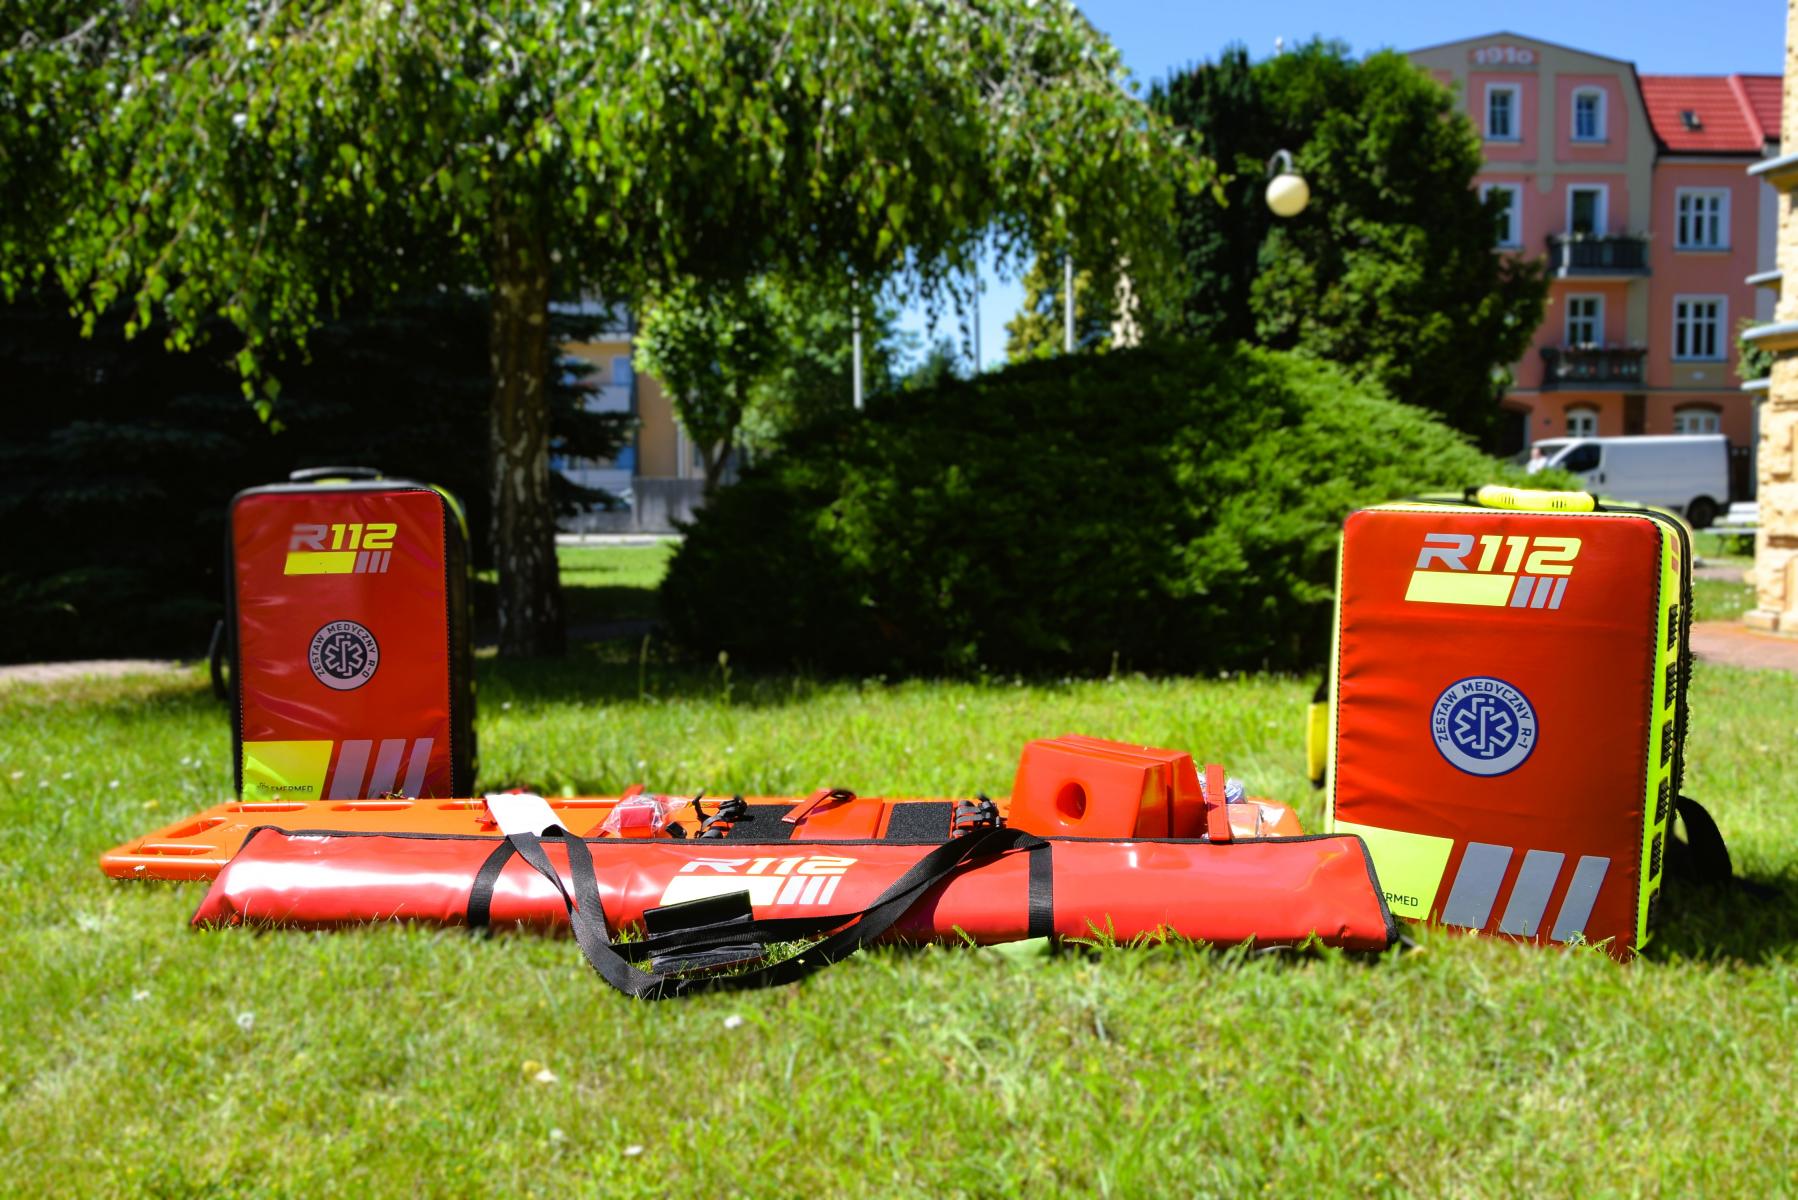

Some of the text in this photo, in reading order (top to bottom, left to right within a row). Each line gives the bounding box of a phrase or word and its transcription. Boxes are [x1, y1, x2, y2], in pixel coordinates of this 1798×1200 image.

[1475, 46, 1534, 64] 1910
[289, 523, 398, 550] R112
[1415, 533, 1582, 575] R112
[311, 634, 326, 677] ZESTAW
[326, 623, 376, 653] MEDYCZNY
[1436, 681, 1532, 749] ZESTAW MEDYCZNY R-1
[679, 855, 858, 875] R112
[1382, 891, 1419, 907] RMED
